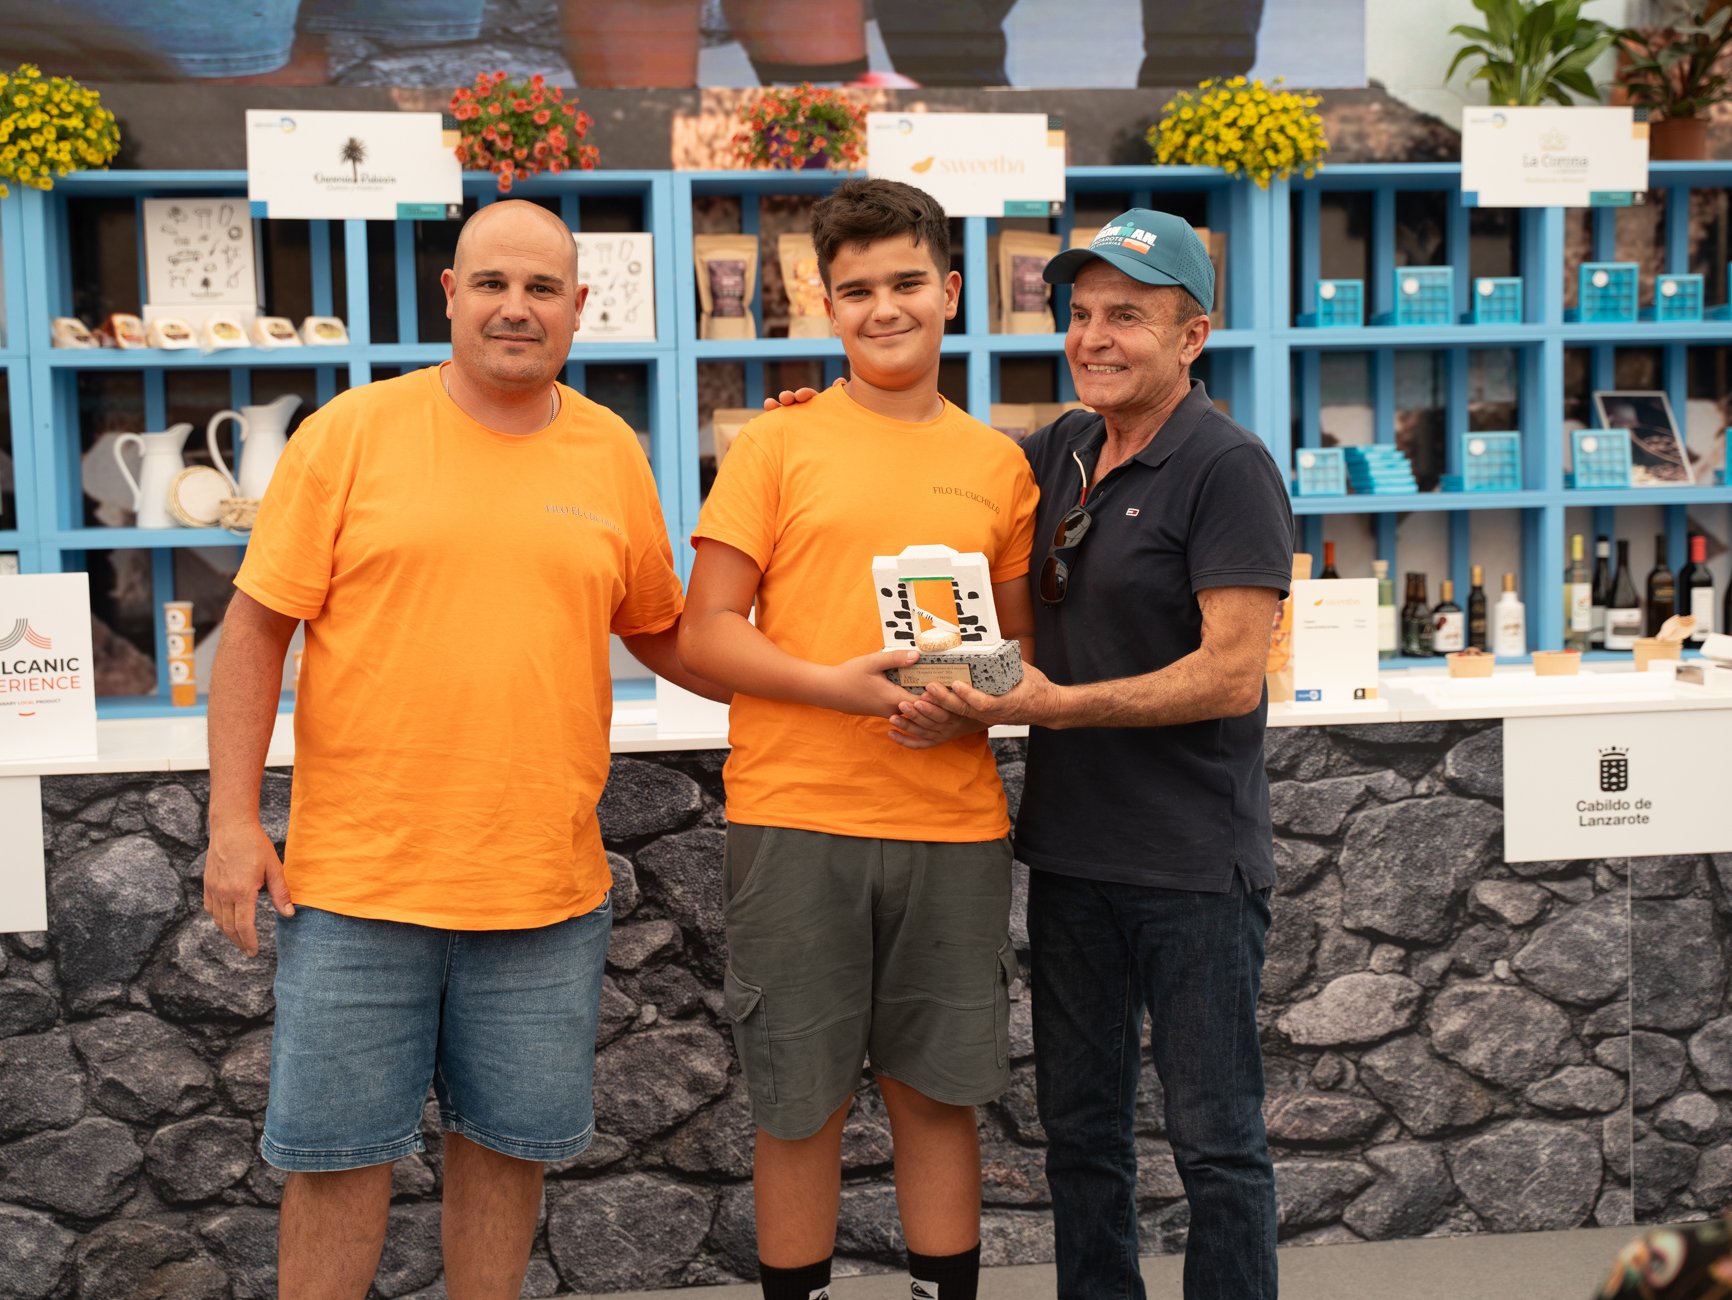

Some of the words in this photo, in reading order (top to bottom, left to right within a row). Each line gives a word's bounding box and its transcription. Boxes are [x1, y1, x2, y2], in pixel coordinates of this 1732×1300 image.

[932, 486, 953, 495] FILO
[954, 487, 965, 497] EL
[965, 491, 1000, 514] CUCHILLO
[1576, 799, 1630, 812] Cabildo
[1634, 798, 1652, 810] de
[1579, 813, 1650, 827] Lanzarote
